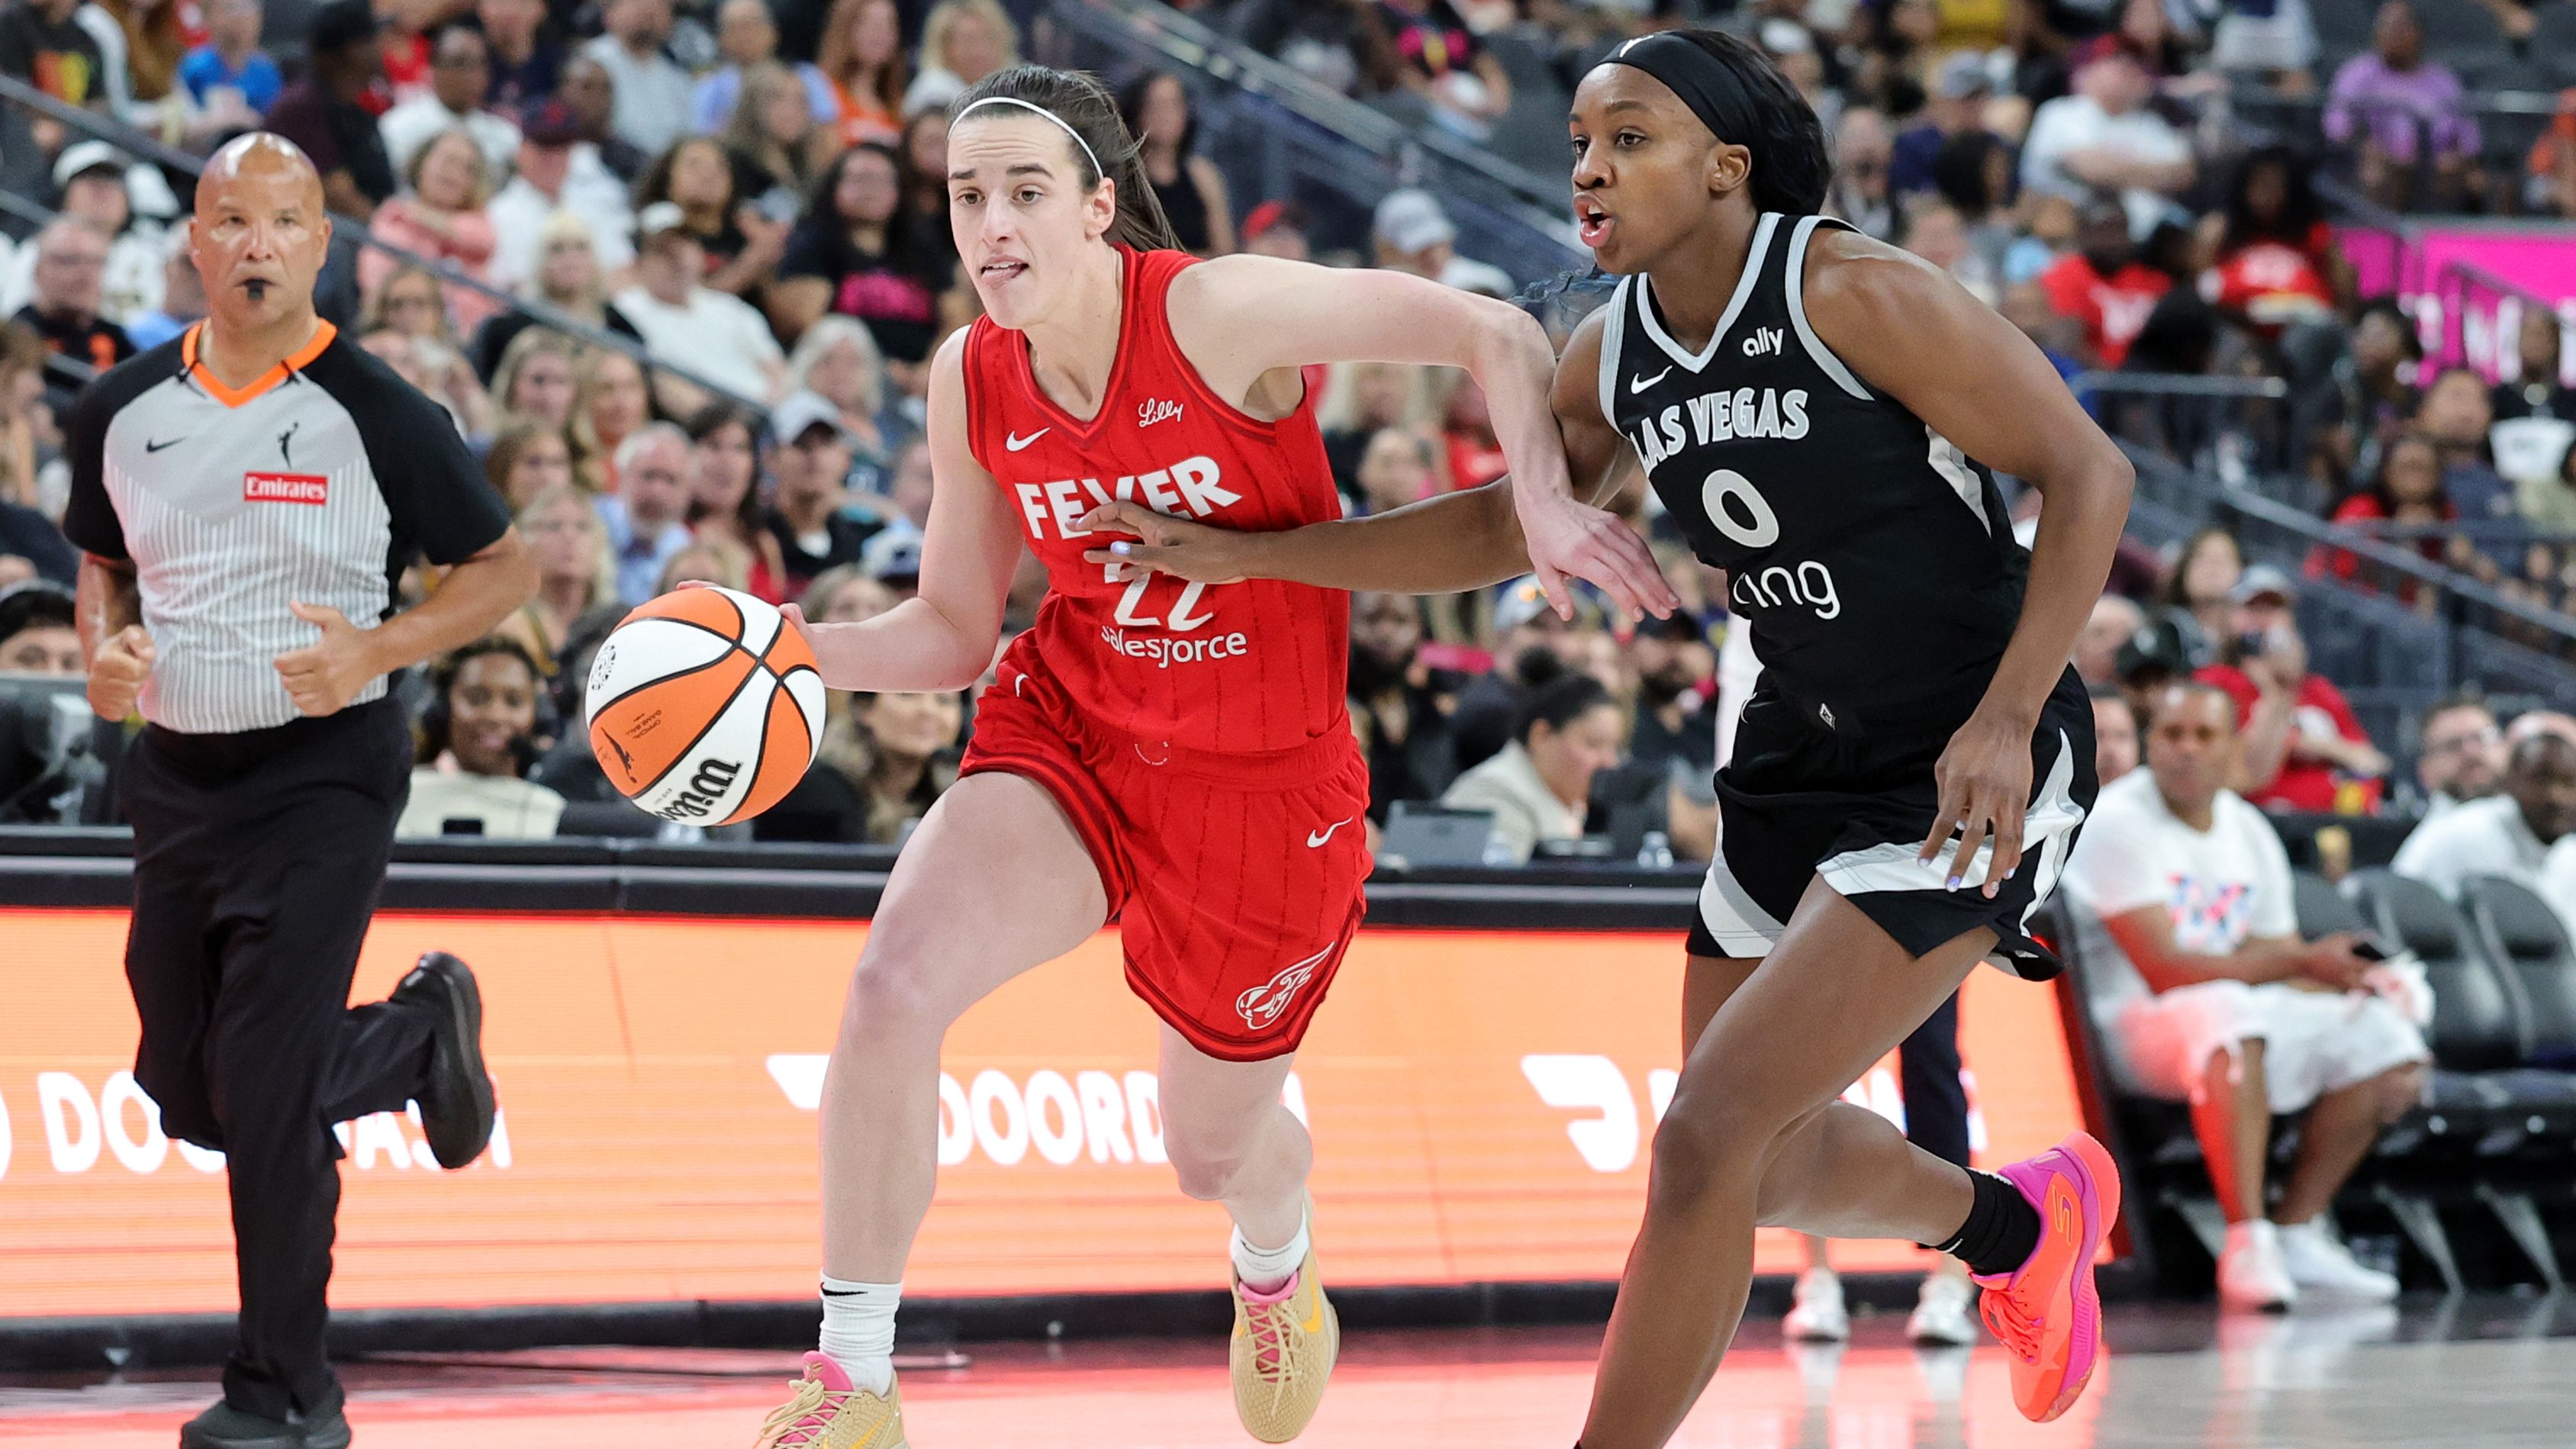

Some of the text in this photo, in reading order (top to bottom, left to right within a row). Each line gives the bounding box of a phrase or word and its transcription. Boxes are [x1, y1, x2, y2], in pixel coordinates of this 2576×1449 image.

[1743, 327, 1784, 356] ally
[1138, 398, 1184, 427] Lilly
[1686, 387, 1810, 446] VEGAS
[246, 476, 326, 500] Emirates
[1014, 456, 1242, 539] FEVER
[1702, 469, 1780, 548] 0
[1104, 563, 1213, 632] 22
[1101, 625, 1248, 668] salesforce
[655, 758, 742, 822] Wilso
[938, 1068, 1309, 1166] DOORD
